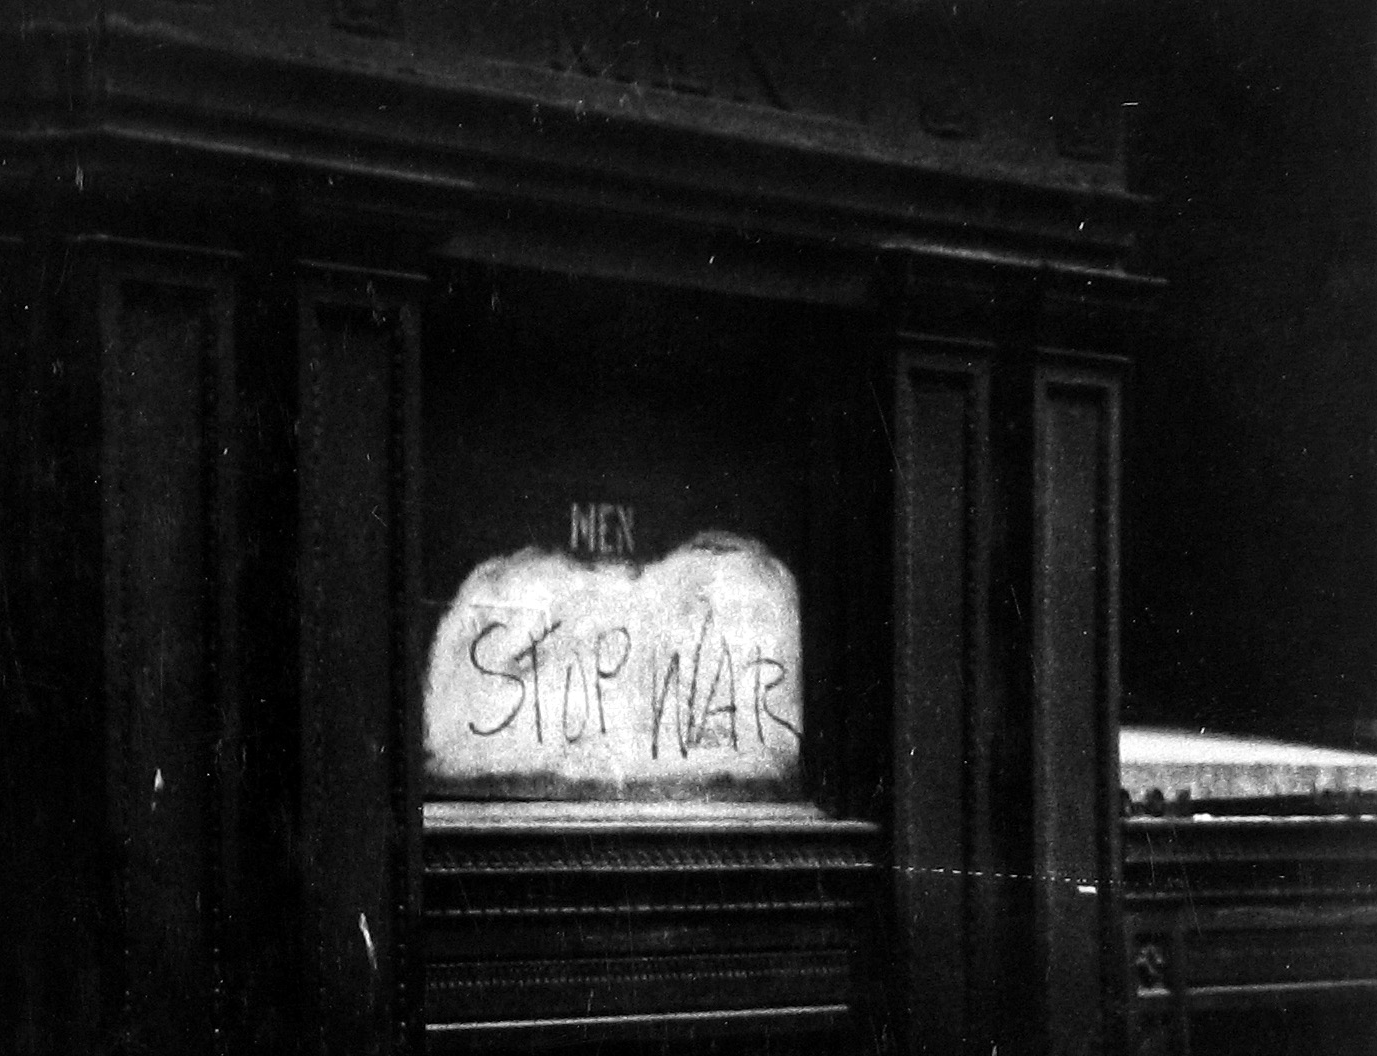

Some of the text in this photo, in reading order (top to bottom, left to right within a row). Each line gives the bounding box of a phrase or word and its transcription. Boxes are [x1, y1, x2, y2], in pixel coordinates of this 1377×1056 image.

[568, 502, 635, 554] MEN
[469, 607, 803, 759] STOP WAR
